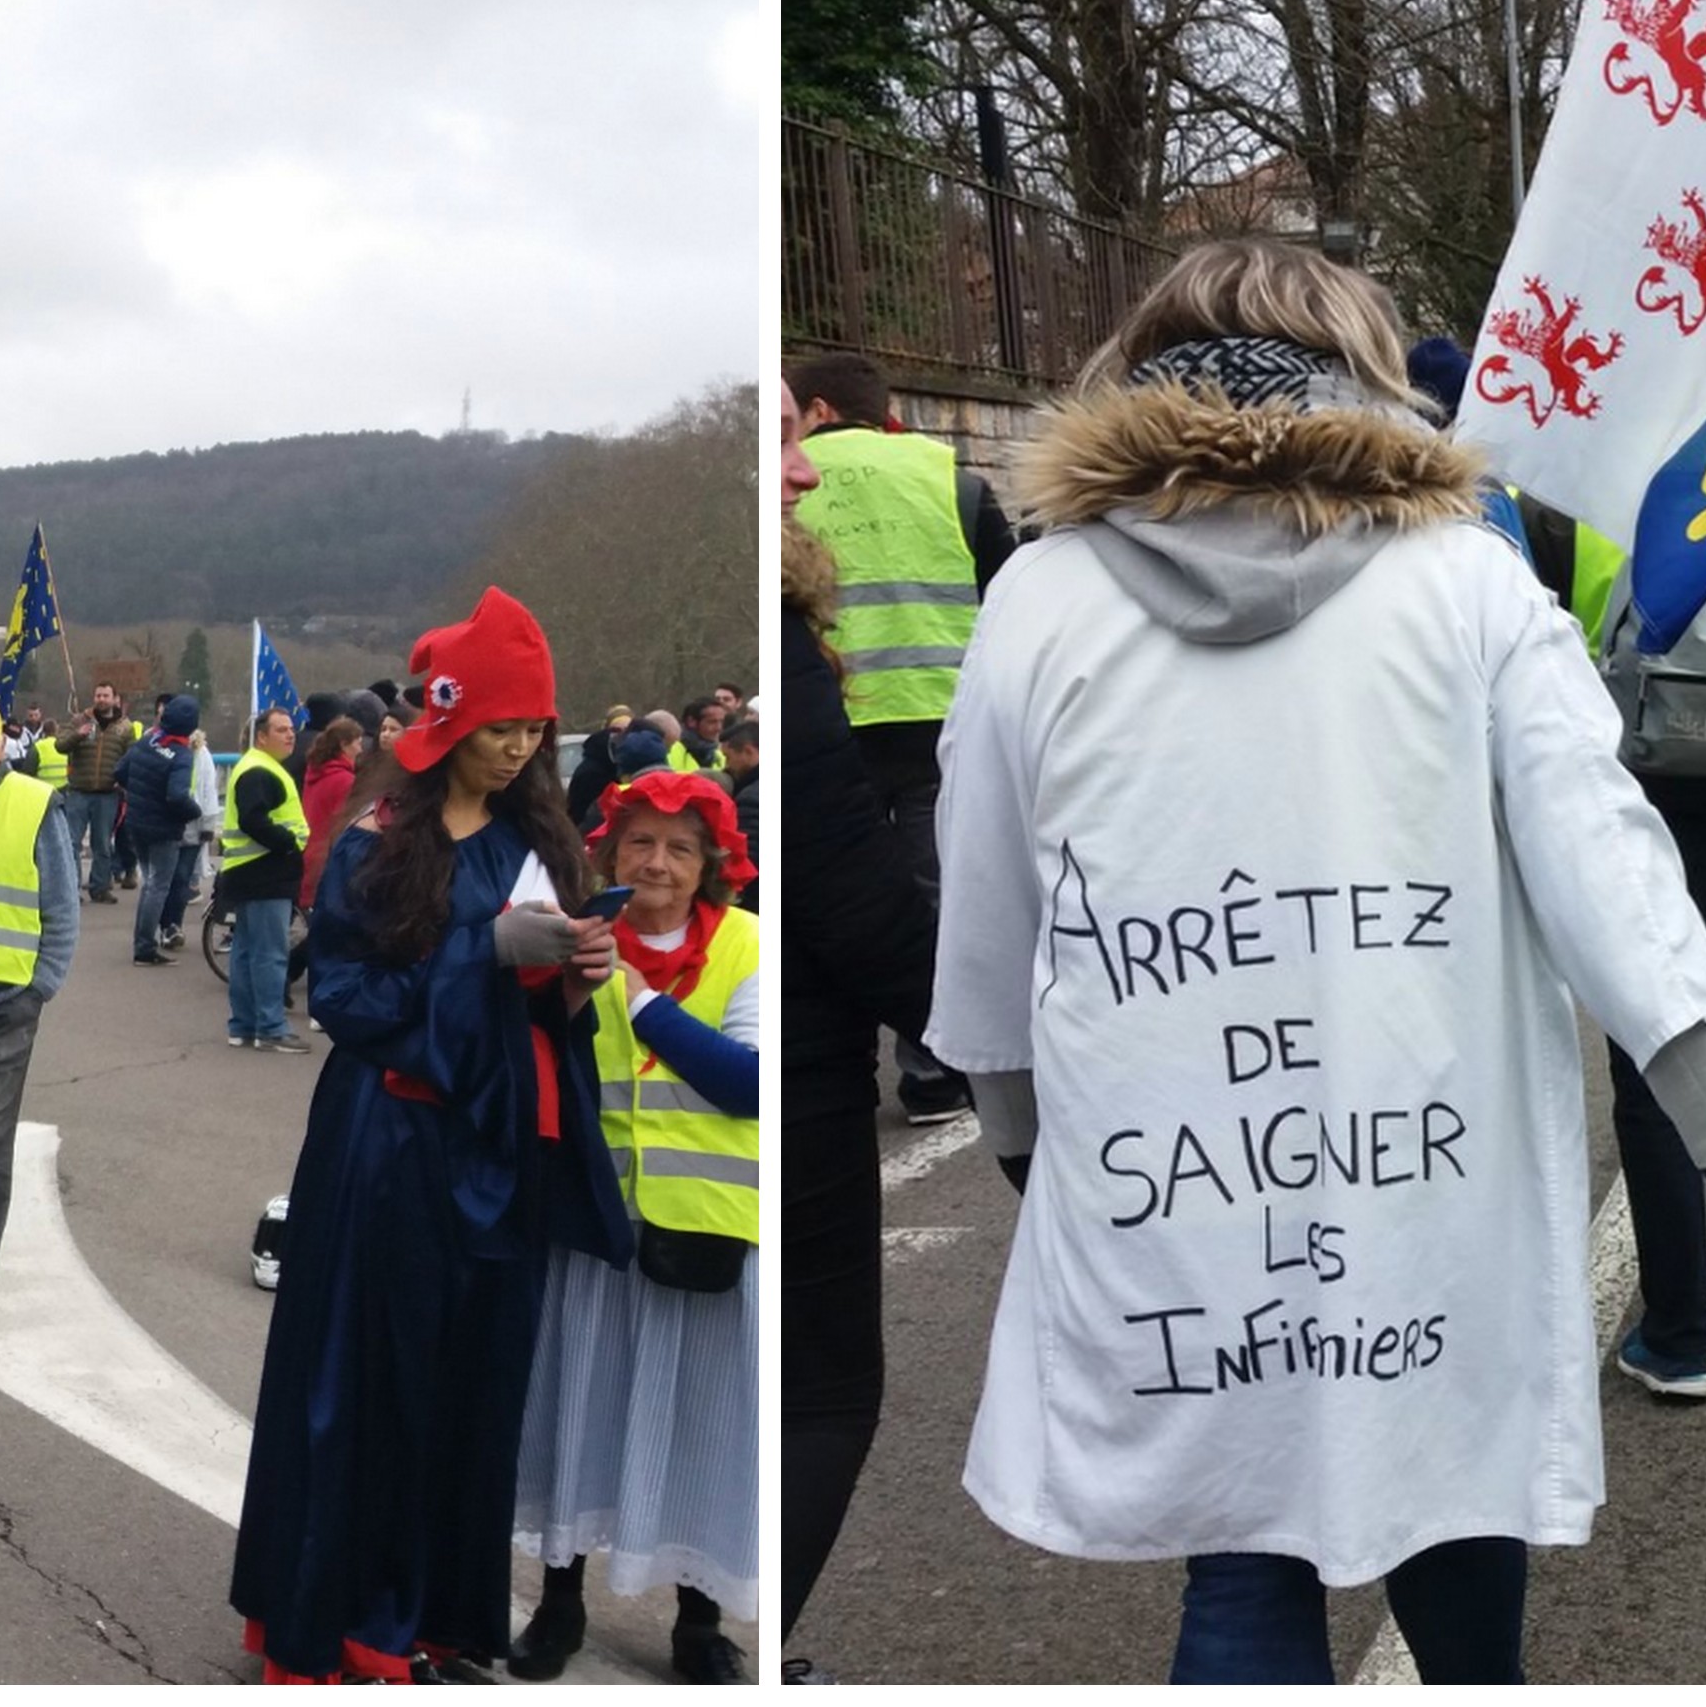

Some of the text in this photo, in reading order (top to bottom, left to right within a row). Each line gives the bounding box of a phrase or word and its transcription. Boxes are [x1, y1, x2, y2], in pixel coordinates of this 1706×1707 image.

[821, 465, 878, 489] TOP
[817, 518, 900, 538] ACKET
[1222, 1019, 1321, 1085] DE
[1100, 1102, 1467, 1229] SAIGNER
